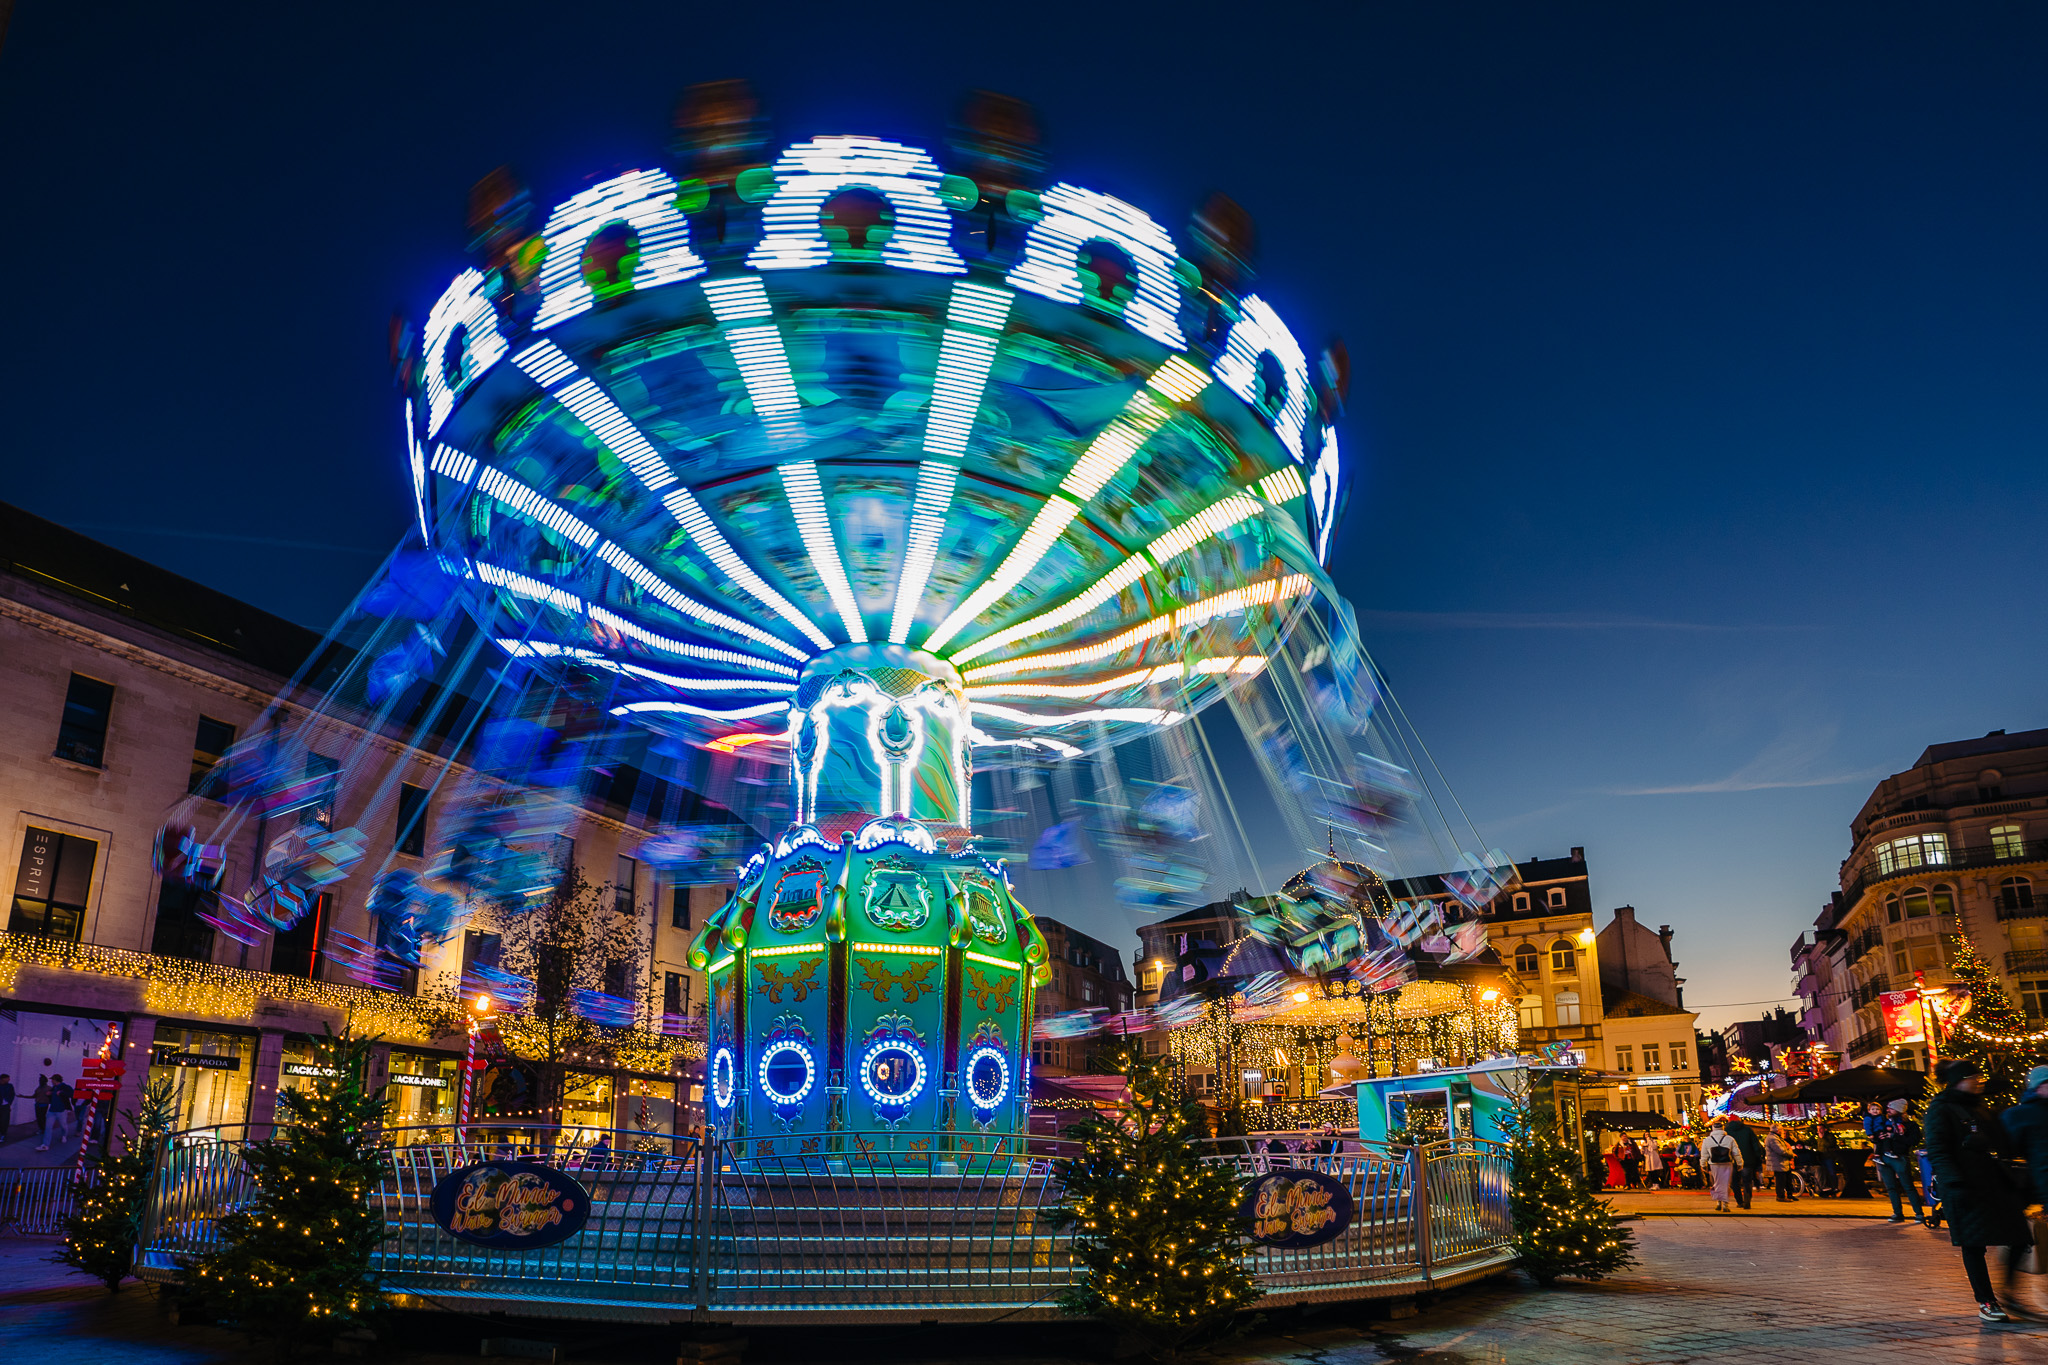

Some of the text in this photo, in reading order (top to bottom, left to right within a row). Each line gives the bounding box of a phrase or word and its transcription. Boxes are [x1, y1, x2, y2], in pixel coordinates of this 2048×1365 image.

[26, 834, 49, 895] ESPRIT
[170, 1056, 228, 1067] VERO MODA
[457, 1179, 561, 1211] El Mundo
[1255, 1185, 1333, 1219] El Mundo
[450, 1206, 563, 1233] Wave Swinger
[1290, 1206, 1337, 1232] Swinger
